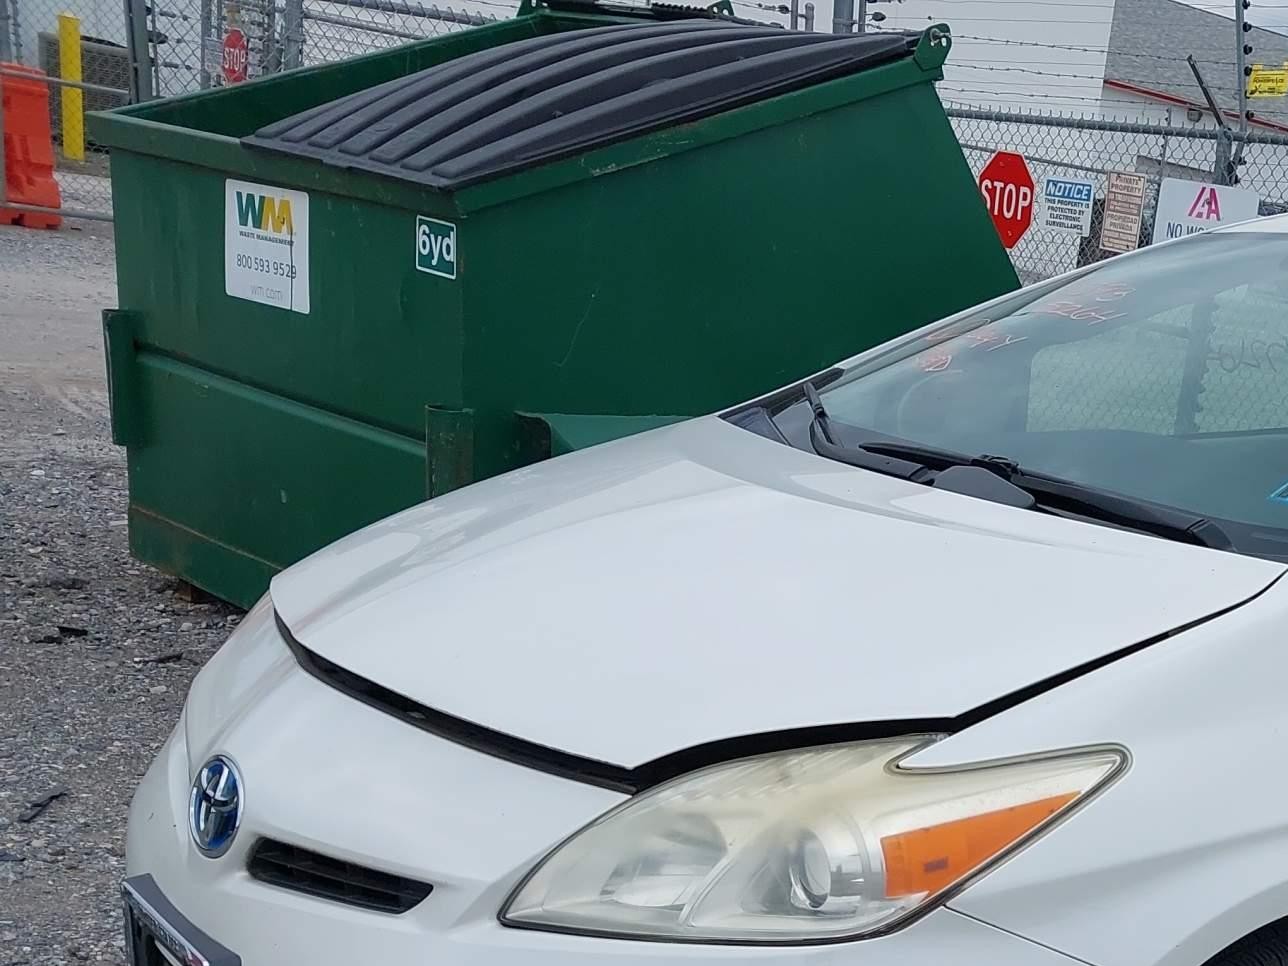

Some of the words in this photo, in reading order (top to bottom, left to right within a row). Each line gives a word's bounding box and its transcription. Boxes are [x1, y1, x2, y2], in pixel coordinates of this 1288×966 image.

[224, 47, 246, 71] STOP
[1110, 183, 1142, 194] PROPERTY
[1115, 175, 1139, 186] PRIVATE
[1047, 182, 1090, 199] NOTICE
[981, 179, 1031, 220] STOP
[1057, 199, 1084, 209] PROPERTY
[236, 191, 294, 235] WM
[1048, 205, 1077, 215] PROTECTED
[1050, 213, 1080, 223] ELECTRONIC
[1045, 220, 1083, 231] SURVEILLANCE
[1166, 221, 1183, 238] NO
[239, 230, 255, 240] WASTE
[256, 234, 295, 247] MANAGEMENT
[419, 224, 454, 266] 6yd
[236, 254, 252, 269] 800
[254, 259, 271, 274] 593
[272, 262, 297, 280] 9529
